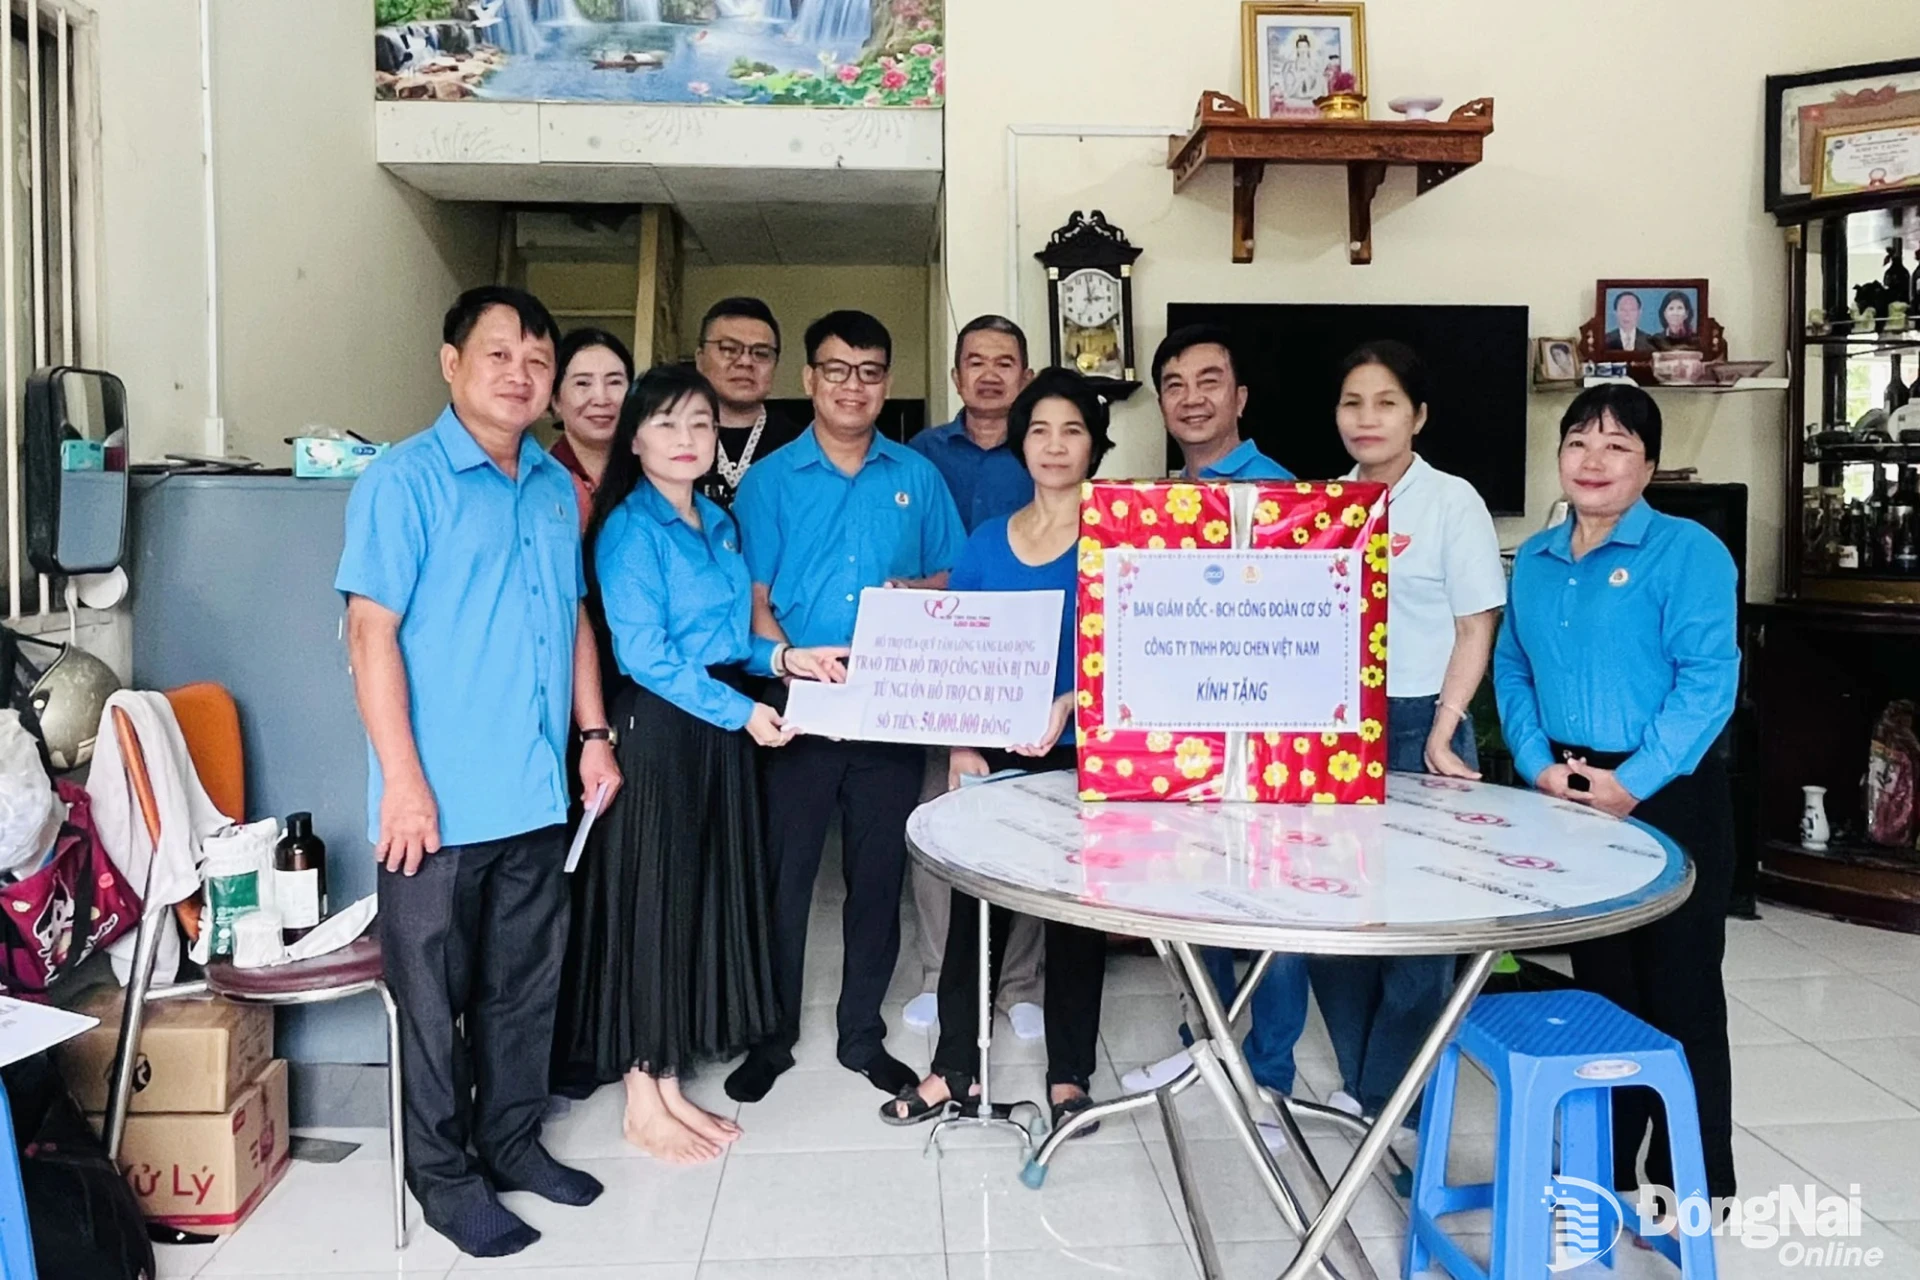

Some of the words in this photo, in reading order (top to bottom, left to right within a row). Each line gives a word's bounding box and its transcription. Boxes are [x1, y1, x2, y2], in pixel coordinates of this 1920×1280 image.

[1133, 601, 1154, 617] BAN
[1156, 598, 1184, 618] GIÁM
[1186, 596, 1208, 618] ĐỐC
[1216, 601, 1236, 618] BCH
[1238, 598, 1267, 618] CÔNG
[1269, 598, 1299, 618] ĐOÀN
[1300, 601, 1316, 618] CƠ
[1317, 596, 1333, 618] SỞ
[1144, 635, 1173, 656] CÔNG
[1175, 640, 1188, 656] TY
[1189, 640, 1218, 656] TNHH
[1219, 640, 1241, 656] POU
[1243, 640, 1270, 656] CHEN
[1271, 635, 1294, 660] VIỆT
[1295, 640, 1320, 656] NAM
[1196, 676, 1230, 701] KÍNH
[1232, 676, 1269, 706] TẶNG
[172, 1163, 216, 1206] Lý
